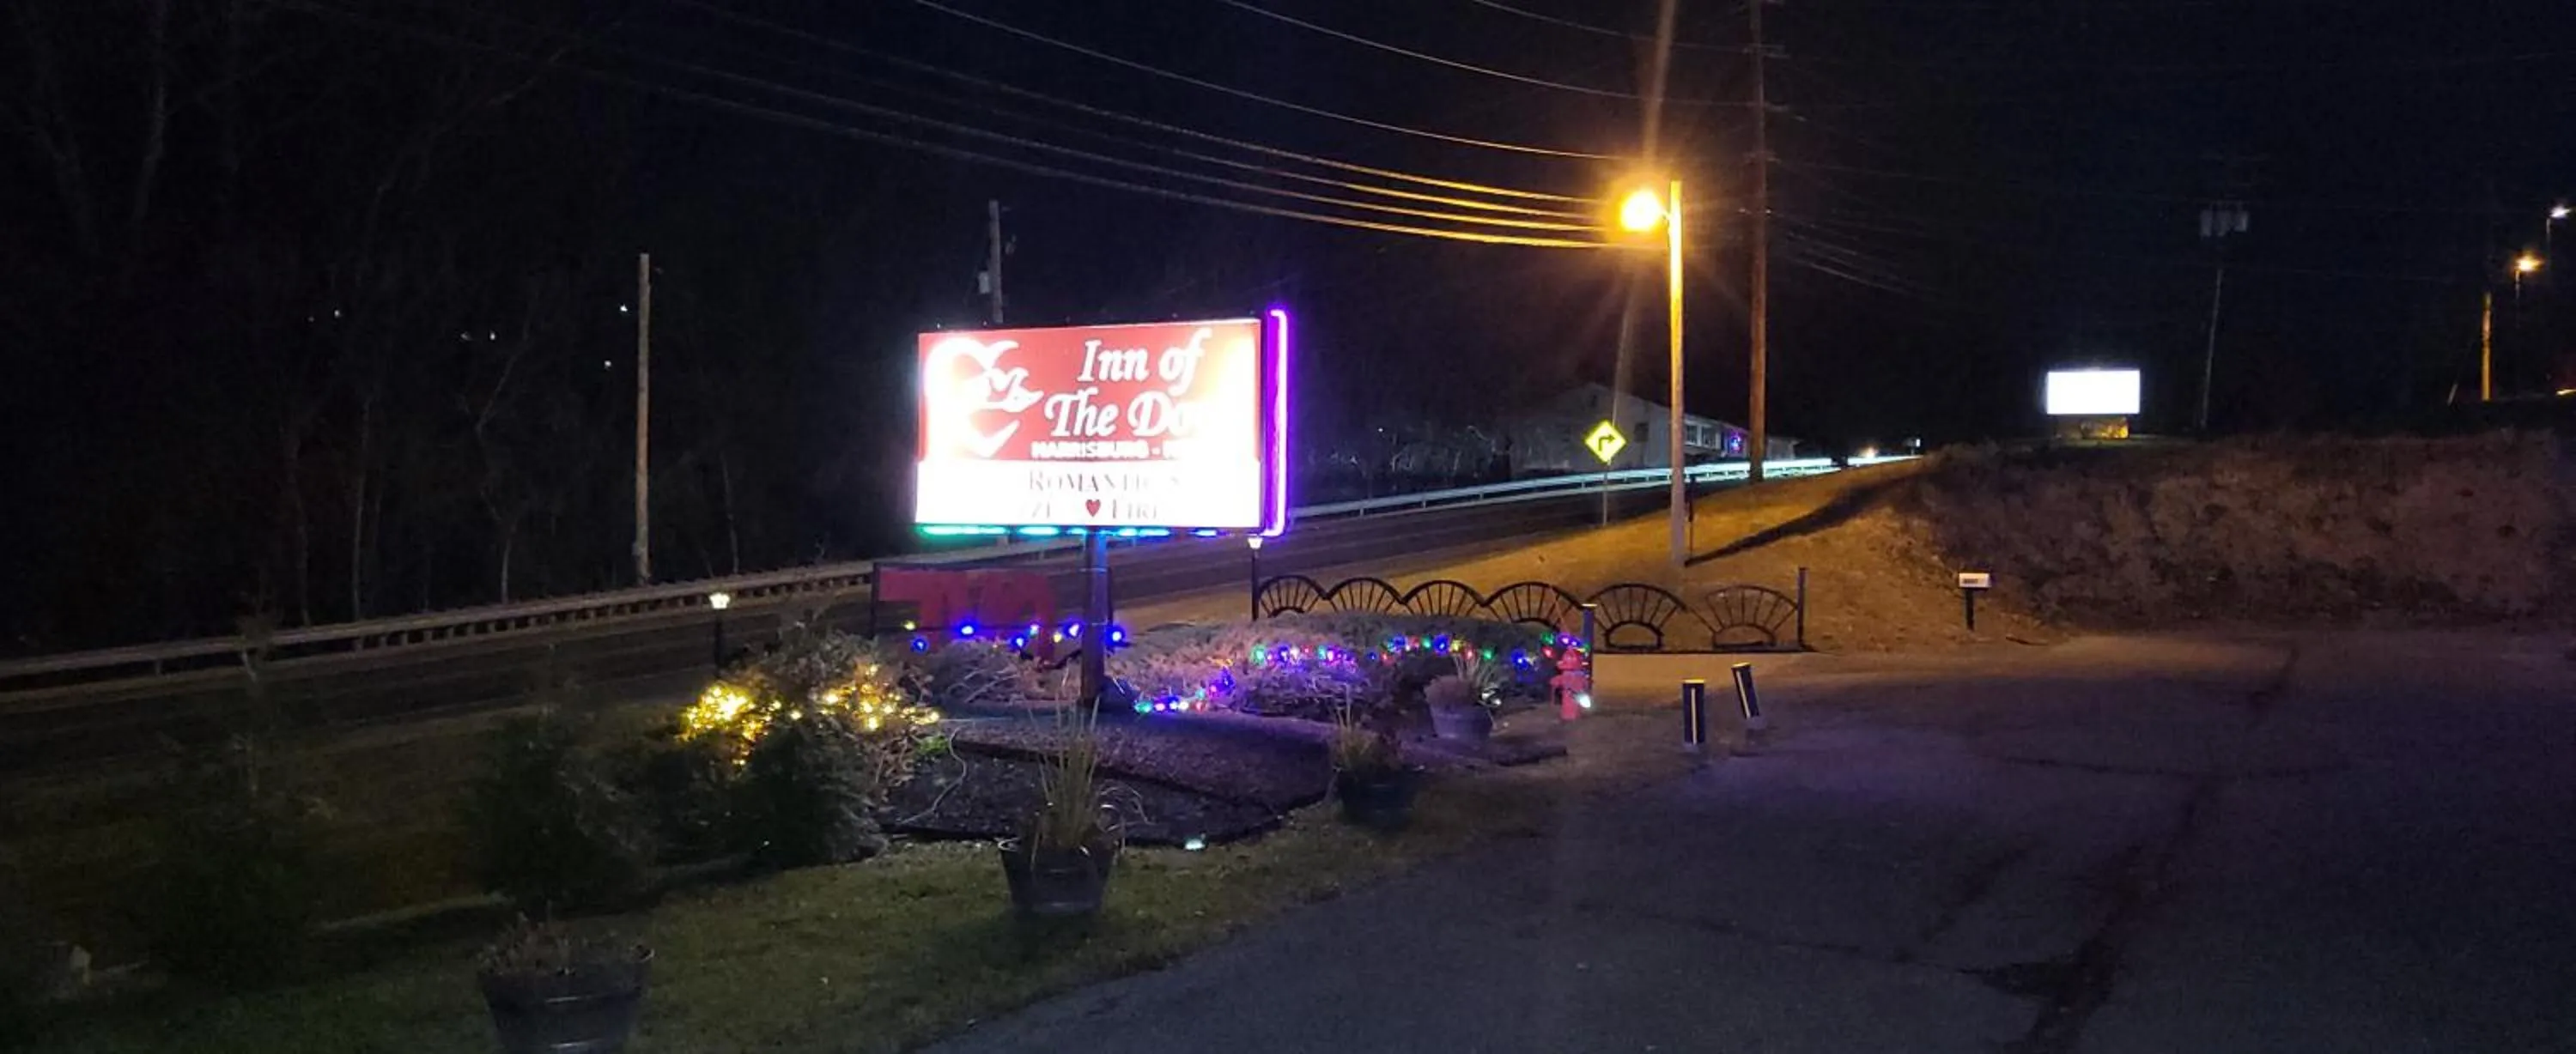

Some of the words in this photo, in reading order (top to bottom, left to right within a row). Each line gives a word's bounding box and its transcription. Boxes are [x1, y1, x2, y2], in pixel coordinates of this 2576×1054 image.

[1077, 339, 1151, 383] Inn
[1158, 327, 1212, 397] of
[1044, 386, 1119, 437] The
